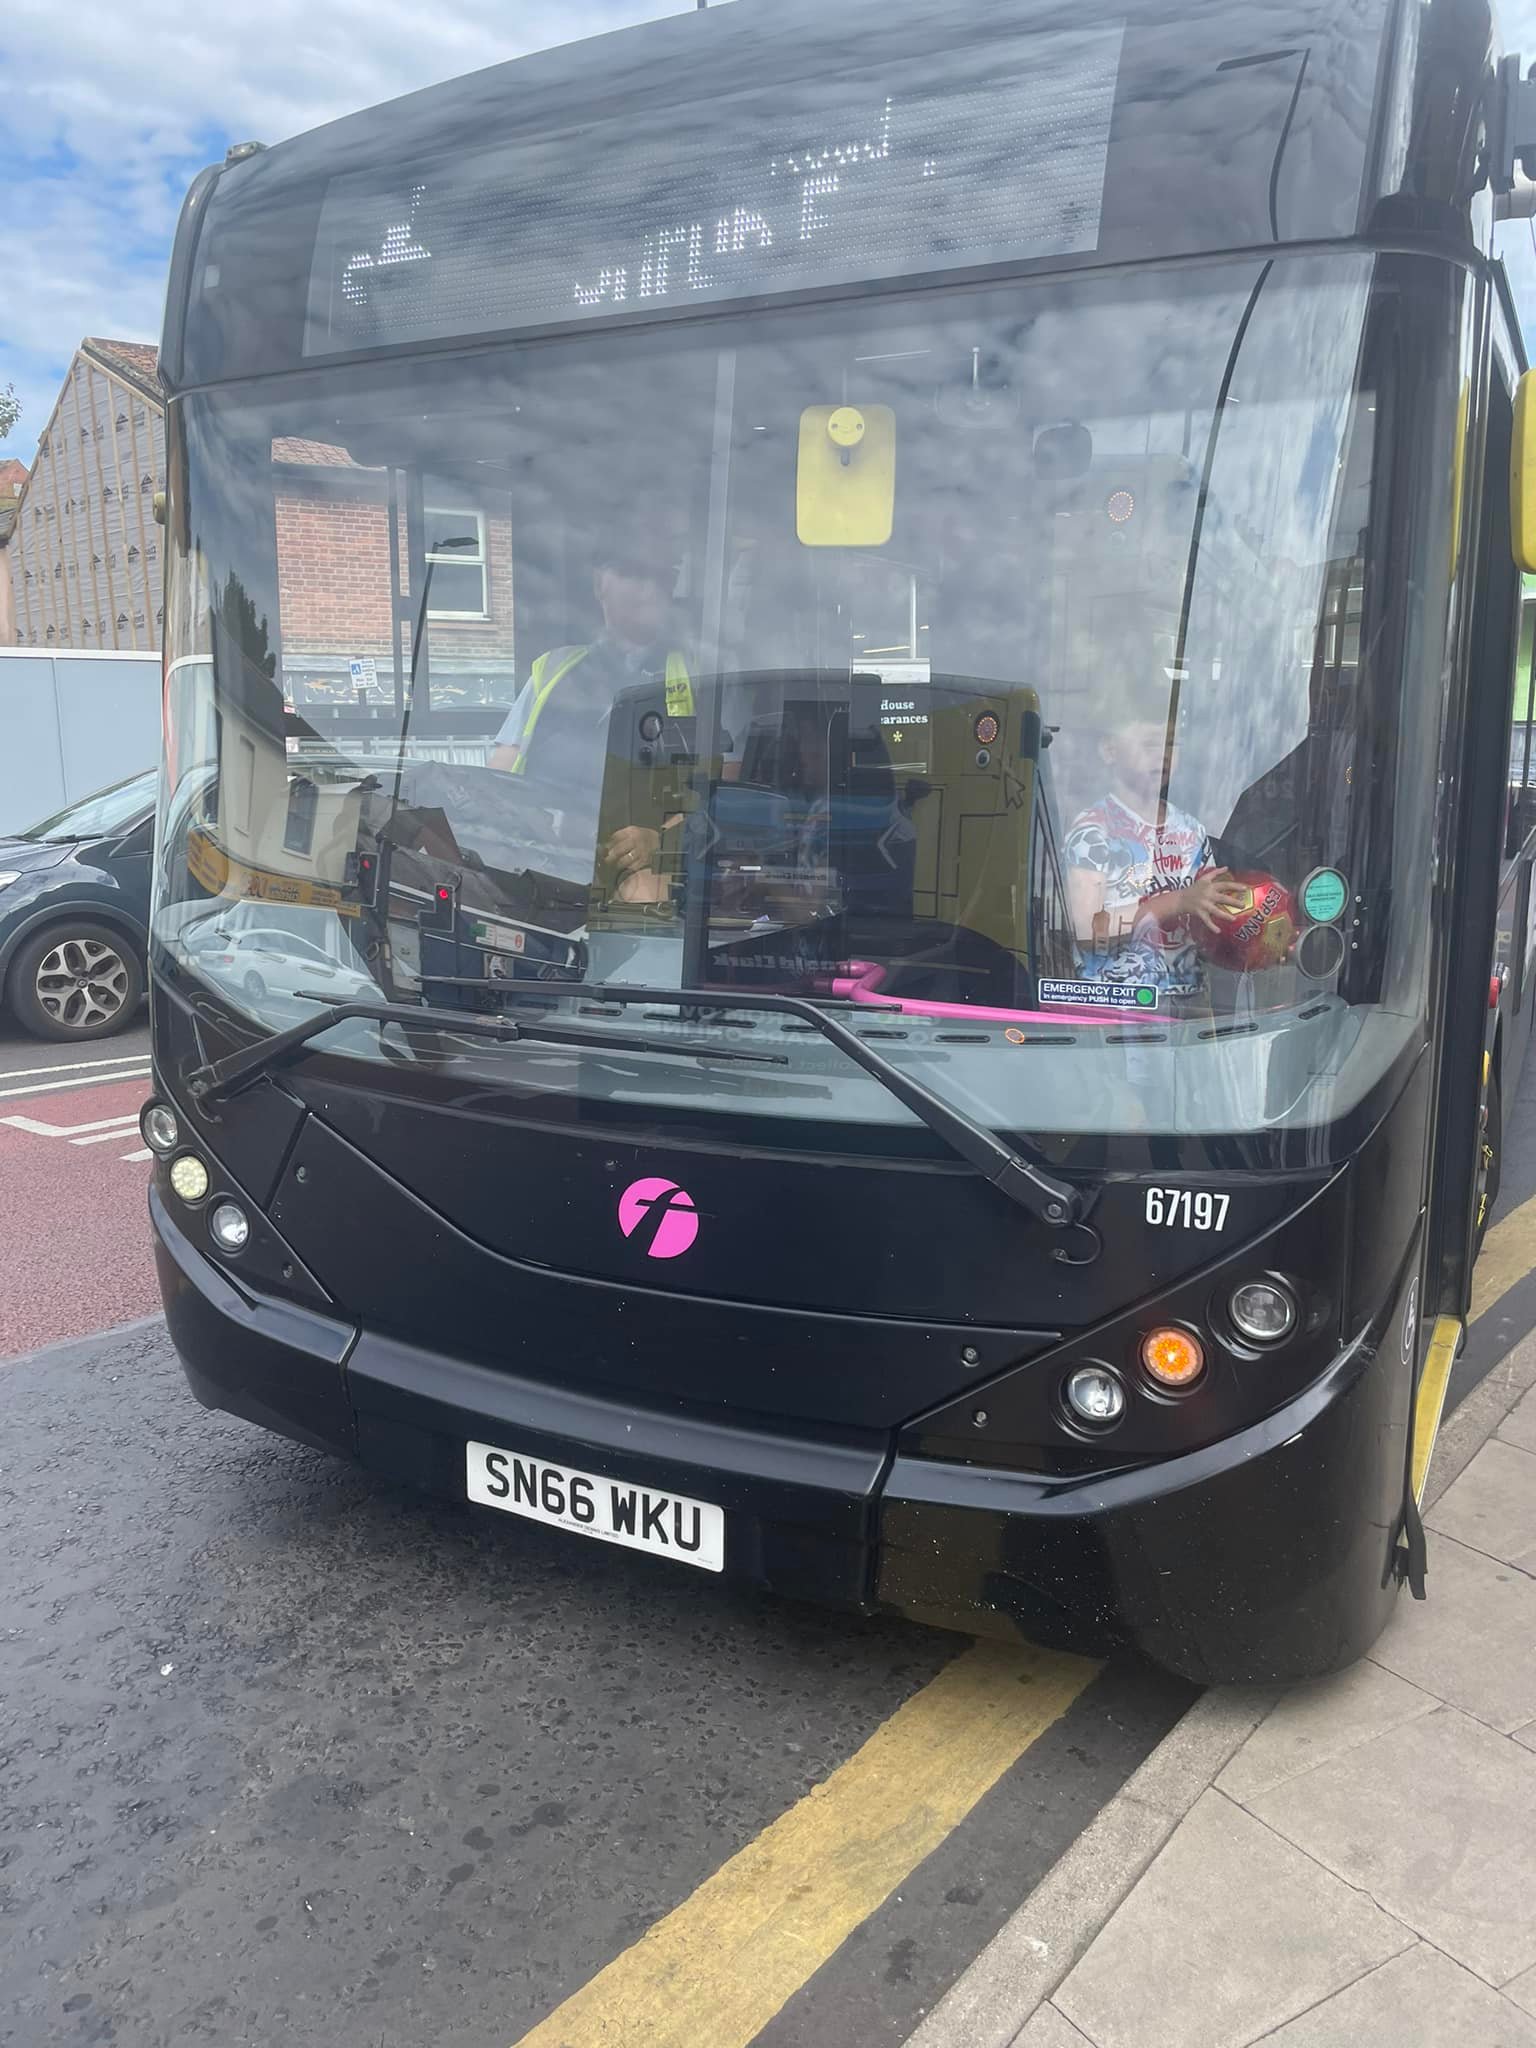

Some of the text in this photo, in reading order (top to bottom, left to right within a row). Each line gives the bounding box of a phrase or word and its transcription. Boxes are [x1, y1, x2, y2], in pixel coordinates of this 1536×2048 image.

[1043, 982, 1137, 997] EMERGENCY EXIT
[1051, 994, 1088, 1003] emergency
[1088, 995, 1110, 1003] PUSH
[1118, 998, 1137, 1006] open
[1145, 1187, 1231, 1232] 67197
[485, 1452, 701, 1552] SN66 WKU
